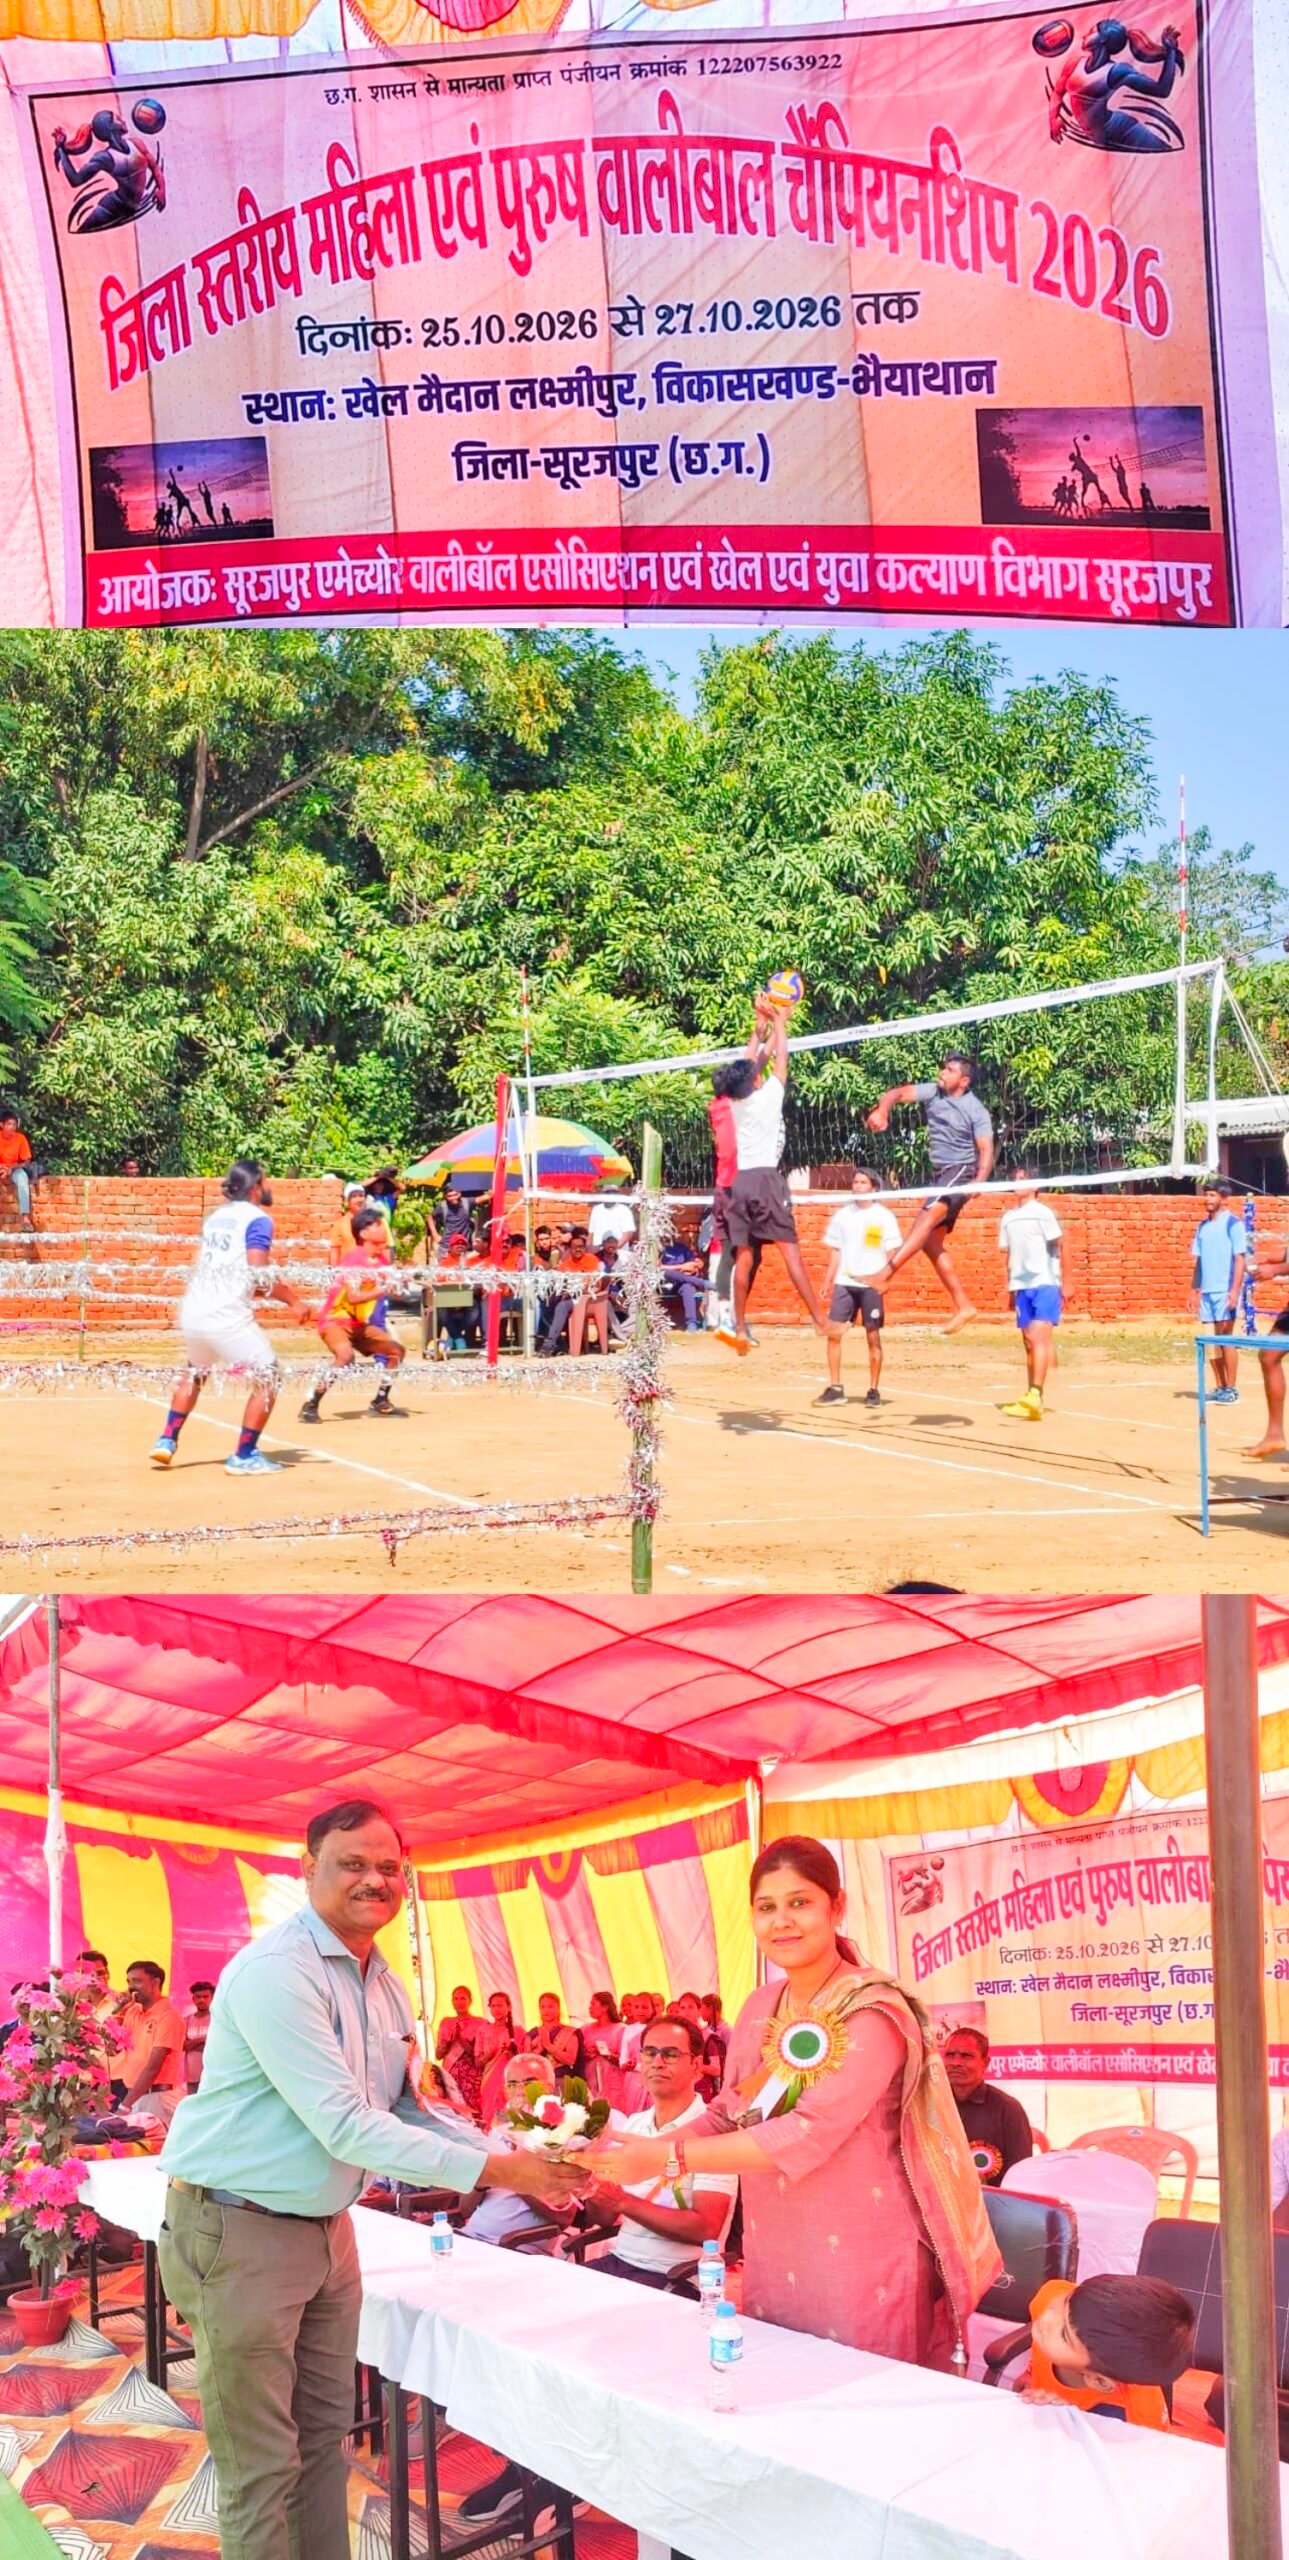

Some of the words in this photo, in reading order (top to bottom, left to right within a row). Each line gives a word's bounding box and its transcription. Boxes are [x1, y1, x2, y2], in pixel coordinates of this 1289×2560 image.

[325, 87, 362, 105] छ.ग.
[369, 83, 417, 102] शासन
[425, 75, 440, 96] से
[447, 76, 506, 95] मान्यता
[514, 70, 552, 90] प्राप्त
[560, 62, 621, 85] पंजीयन
[629, 55, 687, 80] क्रमांक
[698, 53, 843, 76] 122207563922
[100, 275, 190, 390] जिला
[198, 186, 301, 335] स्तरीय
[301, 142, 421, 283] महिला
[421, 123, 488, 262] एवं
[489, 138, 590, 277] पुरुष
[592, 88, 776, 238] वालीबाल
[1030, 201, 1169, 339] 2026
[422, 308, 597, 349] 25.10.2026
[610, 296, 644, 337] से
[656, 294, 841, 336] 27.10.2026
[852, 291, 920, 328] तक
[341, 378, 409, 420] खेल
[413, 375, 500, 414] मैदान
[508, 365, 646, 418] लक्ष्मीपुर,
[653, 351, 997, 402] विकासखण्ड-भैयाथान
[453, 441, 659, 490] जिला-सूरजपुर
[669, 433, 771, 487] (छ.ग.)
[221, 562, 311, 615] सूरजपुर
[314, 544, 404, 599] एमेच्योर
[407, 539, 519, 593] वालीबॉल
[520, 536, 659, 592] एसोसिएशन
[660, 541, 703, 591] एवं
[707, 536, 762, 593] खेल
[768, 542, 811, 592] एवं
[815, 552, 870, 605] युवा
[876, 553, 987, 596] कल्याण
[990, 537, 1089, 600] विभाग
[1093, 558, 1213, 620] सूरजपुर
[912, 1932, 952, 1983] जिला
[955, 1892, 1002, 1960] स्तरीय
[1002, 1869, 1056, 1933] महिला
[1056, 1856, 1085, 1917] एवं
[1087, 1860, 1135, 1926] पुरुष
[1135, 1834, 1211, 1906] वालीबा
[1056, 1940, 1140, 1961] 25.10.2026
[1145, 1934, 1164, 1954] से
[1020, 1974, 1050, 1994] खेल
[1053, 1971, 1093, 1992] मैदान
[1097, 1966, 1166, 1994] लक्ष्मीपुर,
[1071, 2003, 1172, 2027] जिला-सूरजपुर
[1173, 2050, 1193, 2075] एवं
